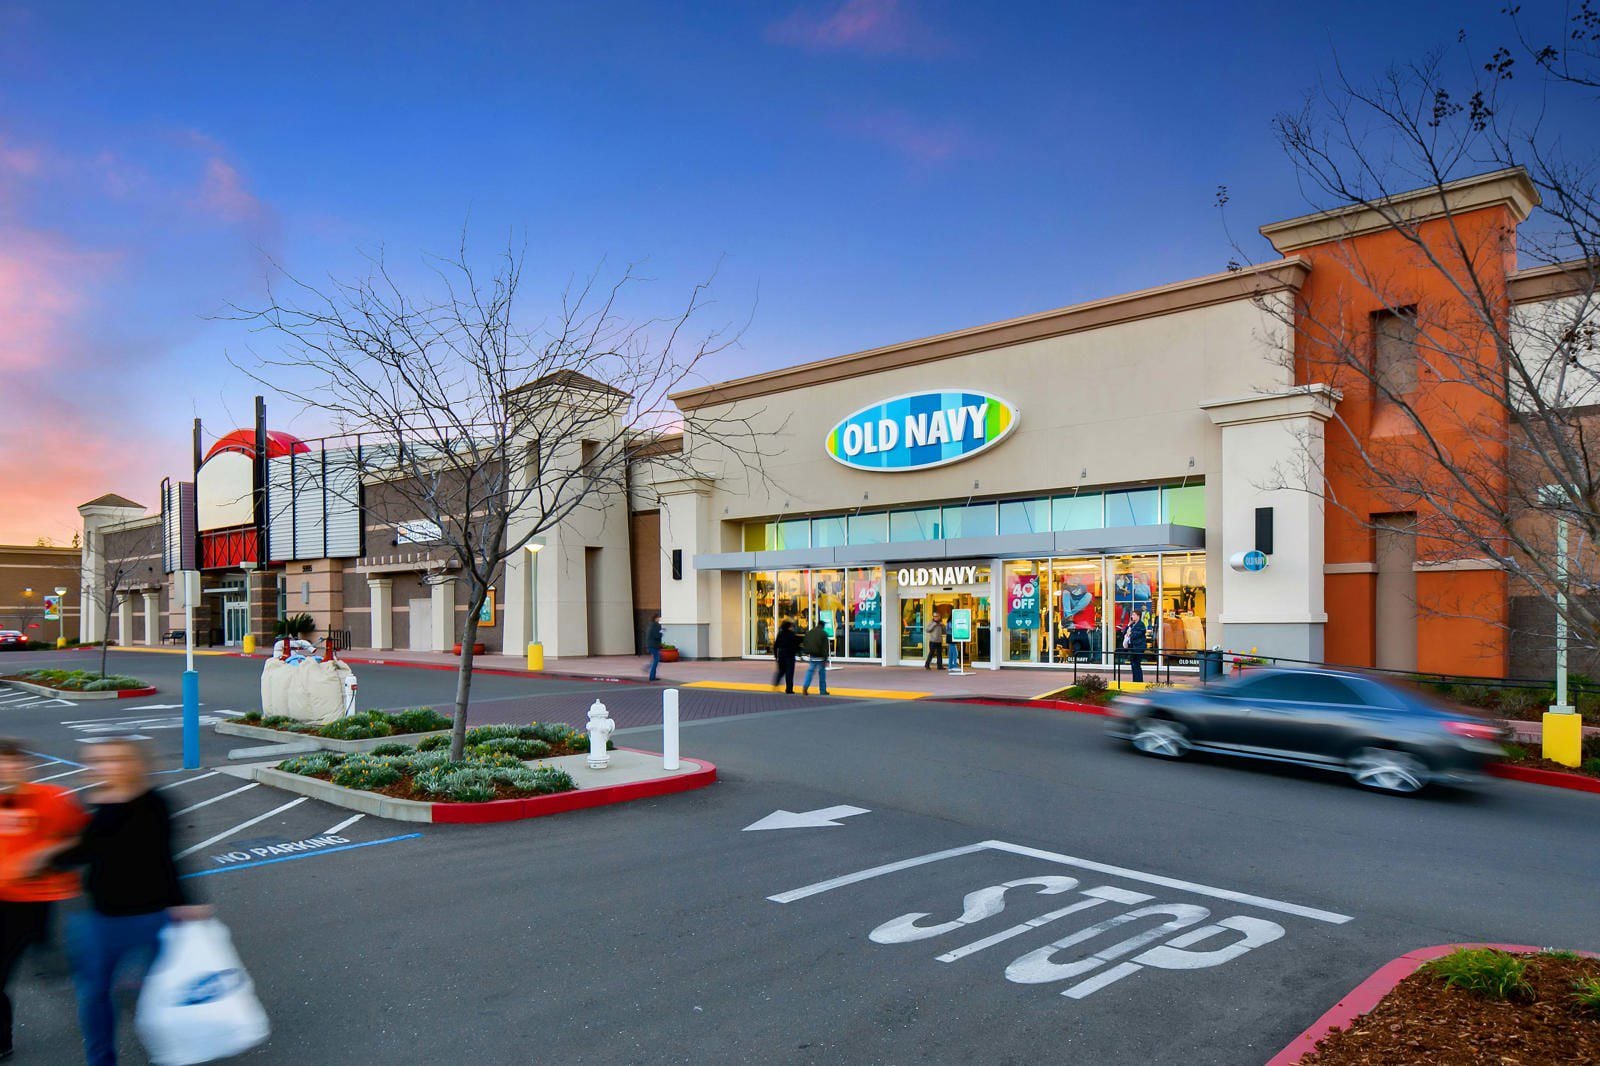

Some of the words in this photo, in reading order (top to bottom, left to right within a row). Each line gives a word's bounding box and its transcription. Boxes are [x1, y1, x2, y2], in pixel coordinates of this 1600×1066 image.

[843, 418, 899, 456] OLD
[905, 403, 988, 448] NAVY
[1245, 556, 1254, 566] OLD
[898, 567, 929, 586] OLD
[930, 565, 977, 586] NAVY
[859, 601, 877, 612] OFF
[1012, 598, 1035, 609] OFF
[210, 850, 252, 864] NO
[249, 835, 351, 857] PARKING
[868, 875, 1286, 1000] STOP
